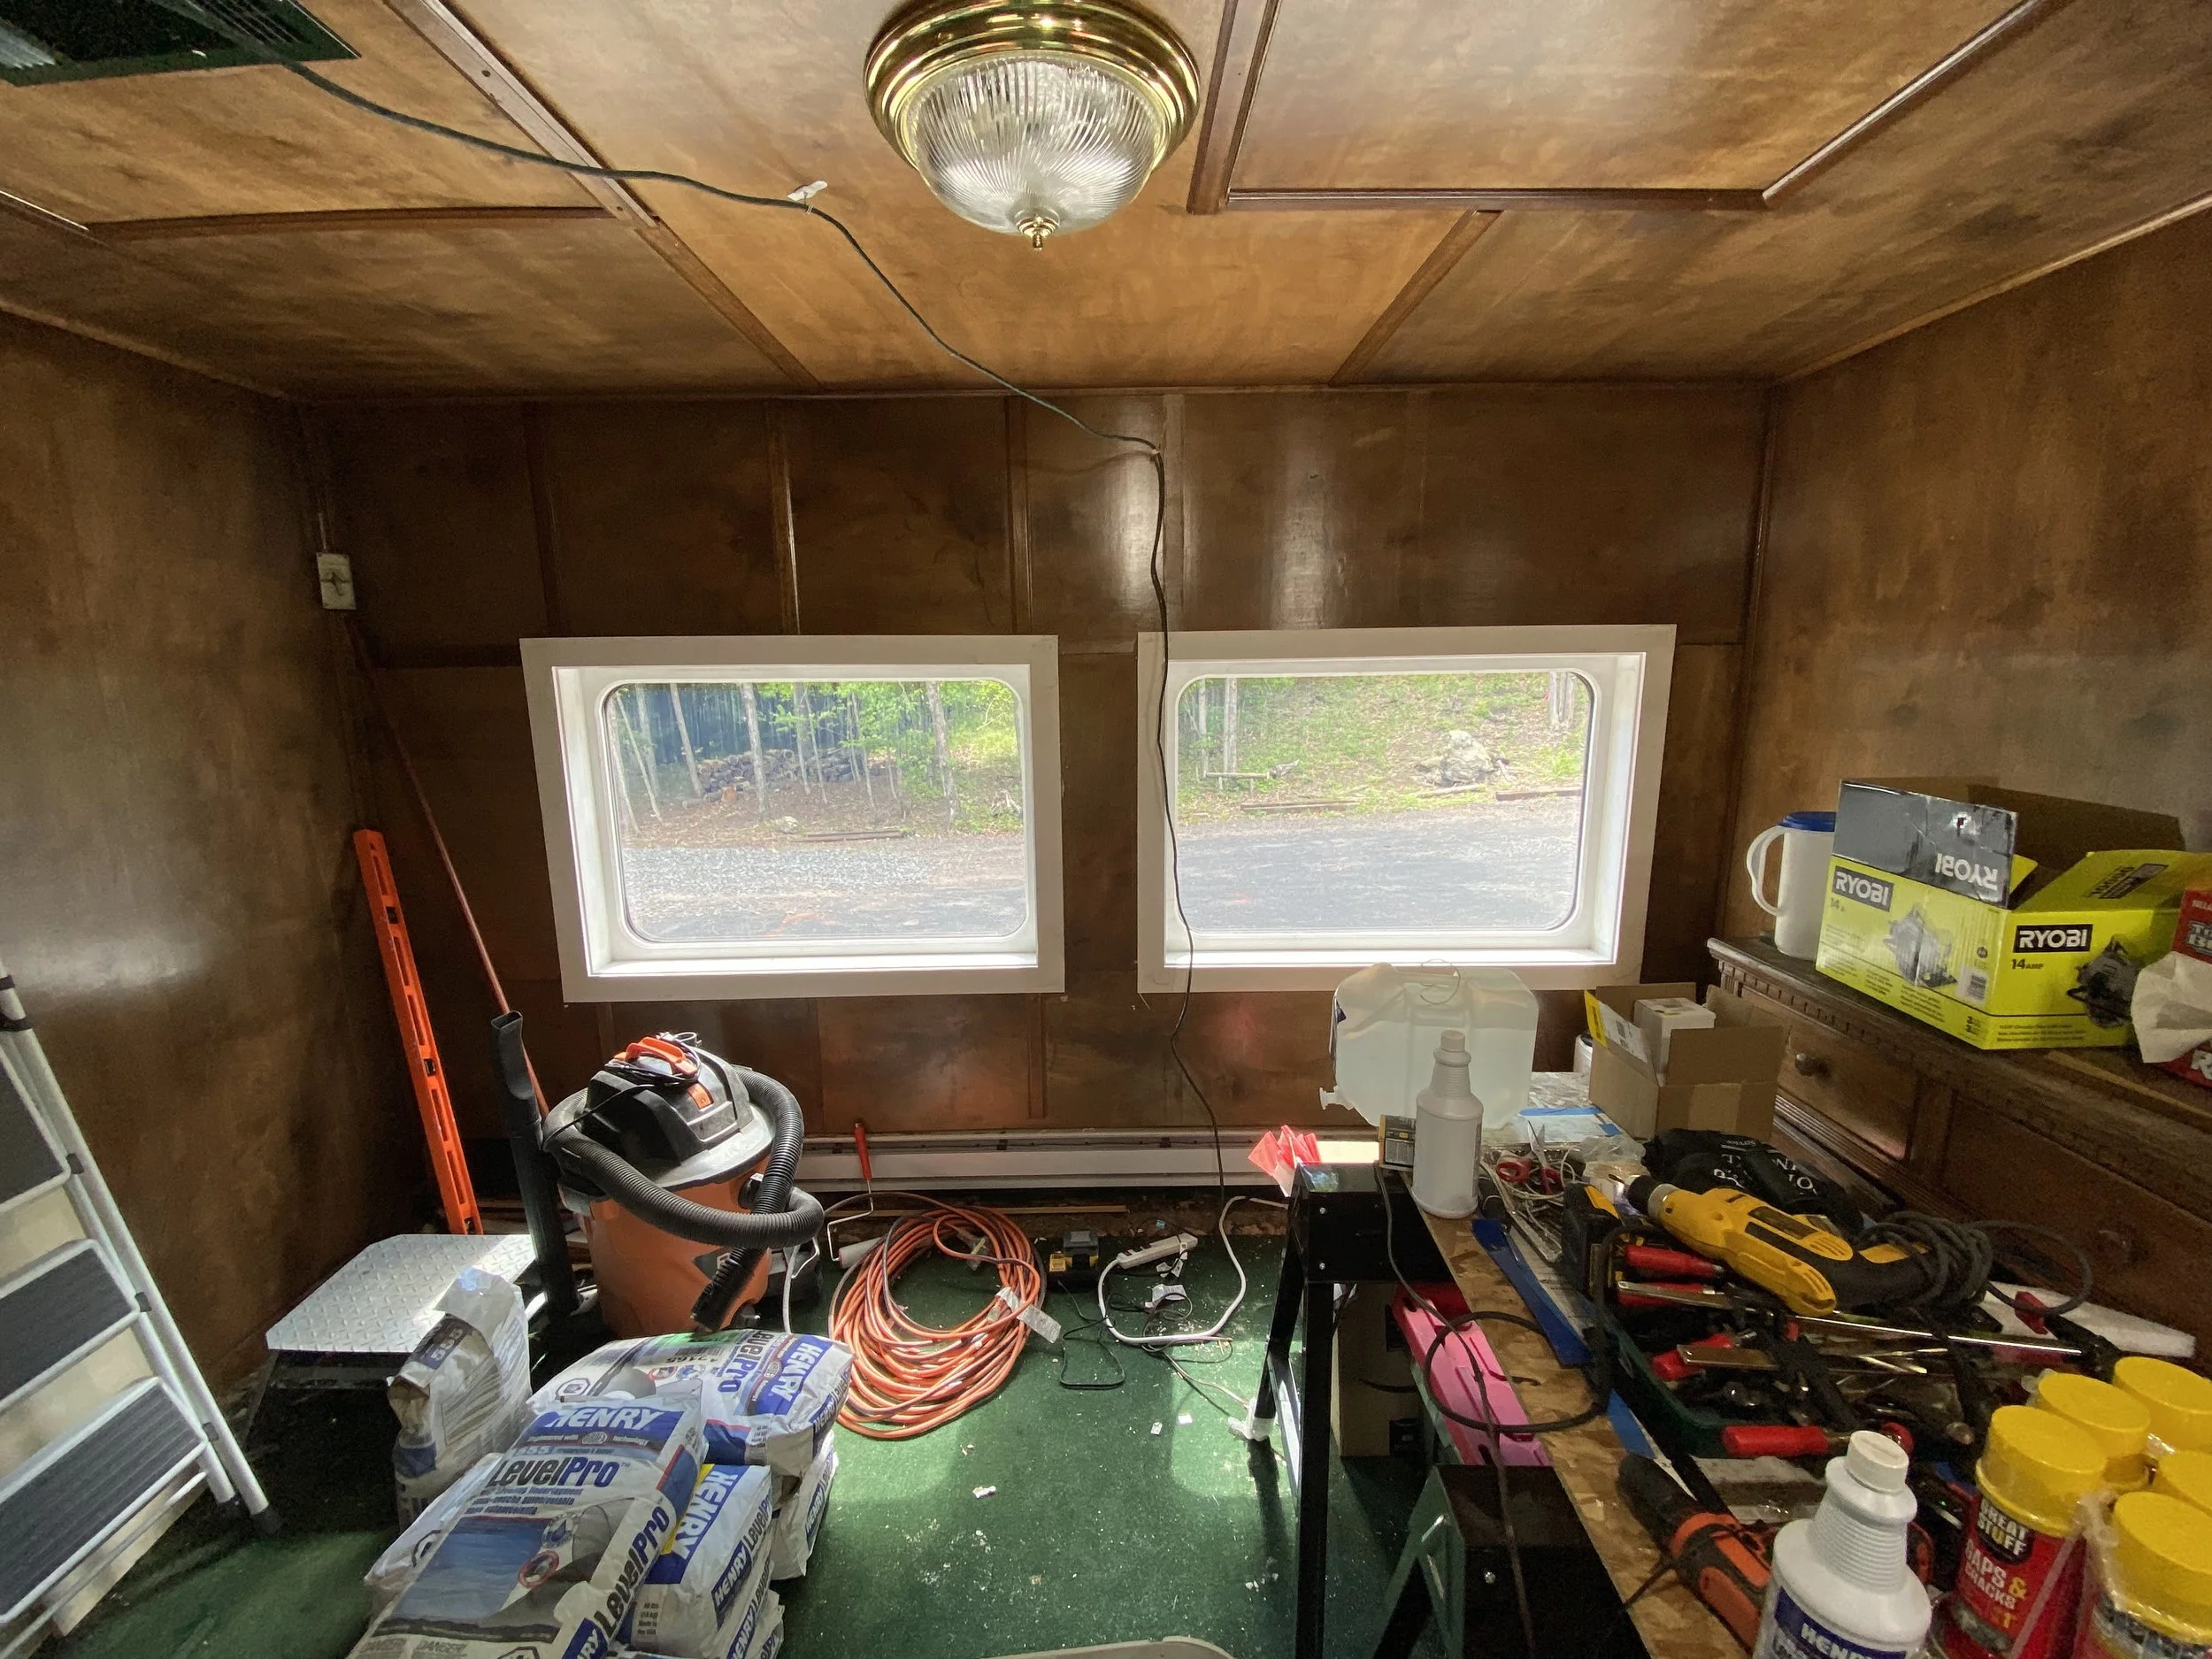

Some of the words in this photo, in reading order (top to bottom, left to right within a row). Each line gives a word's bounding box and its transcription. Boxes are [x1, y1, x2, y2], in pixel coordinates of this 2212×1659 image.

[1834, 870, 1891, 906] RYOBI
[1935, 852, 1999, 891] RYOBI
[2018, 929, 2088, 949] RYOBI
[770, 1341, 825, 1402] HENRY
[543, 1407, 664, 1431] HENRY
[487, 1456, 622, 1488] LevelPro
[673, 1472, 739, 1561] HENRY
[1977, 1514, 2027, 1555] STUFF
[593, 1506, 671, 1638] LevelPro
[713, 1546, 750, 1607] HENRY
[2008, 1576, 2027, 1600] &
